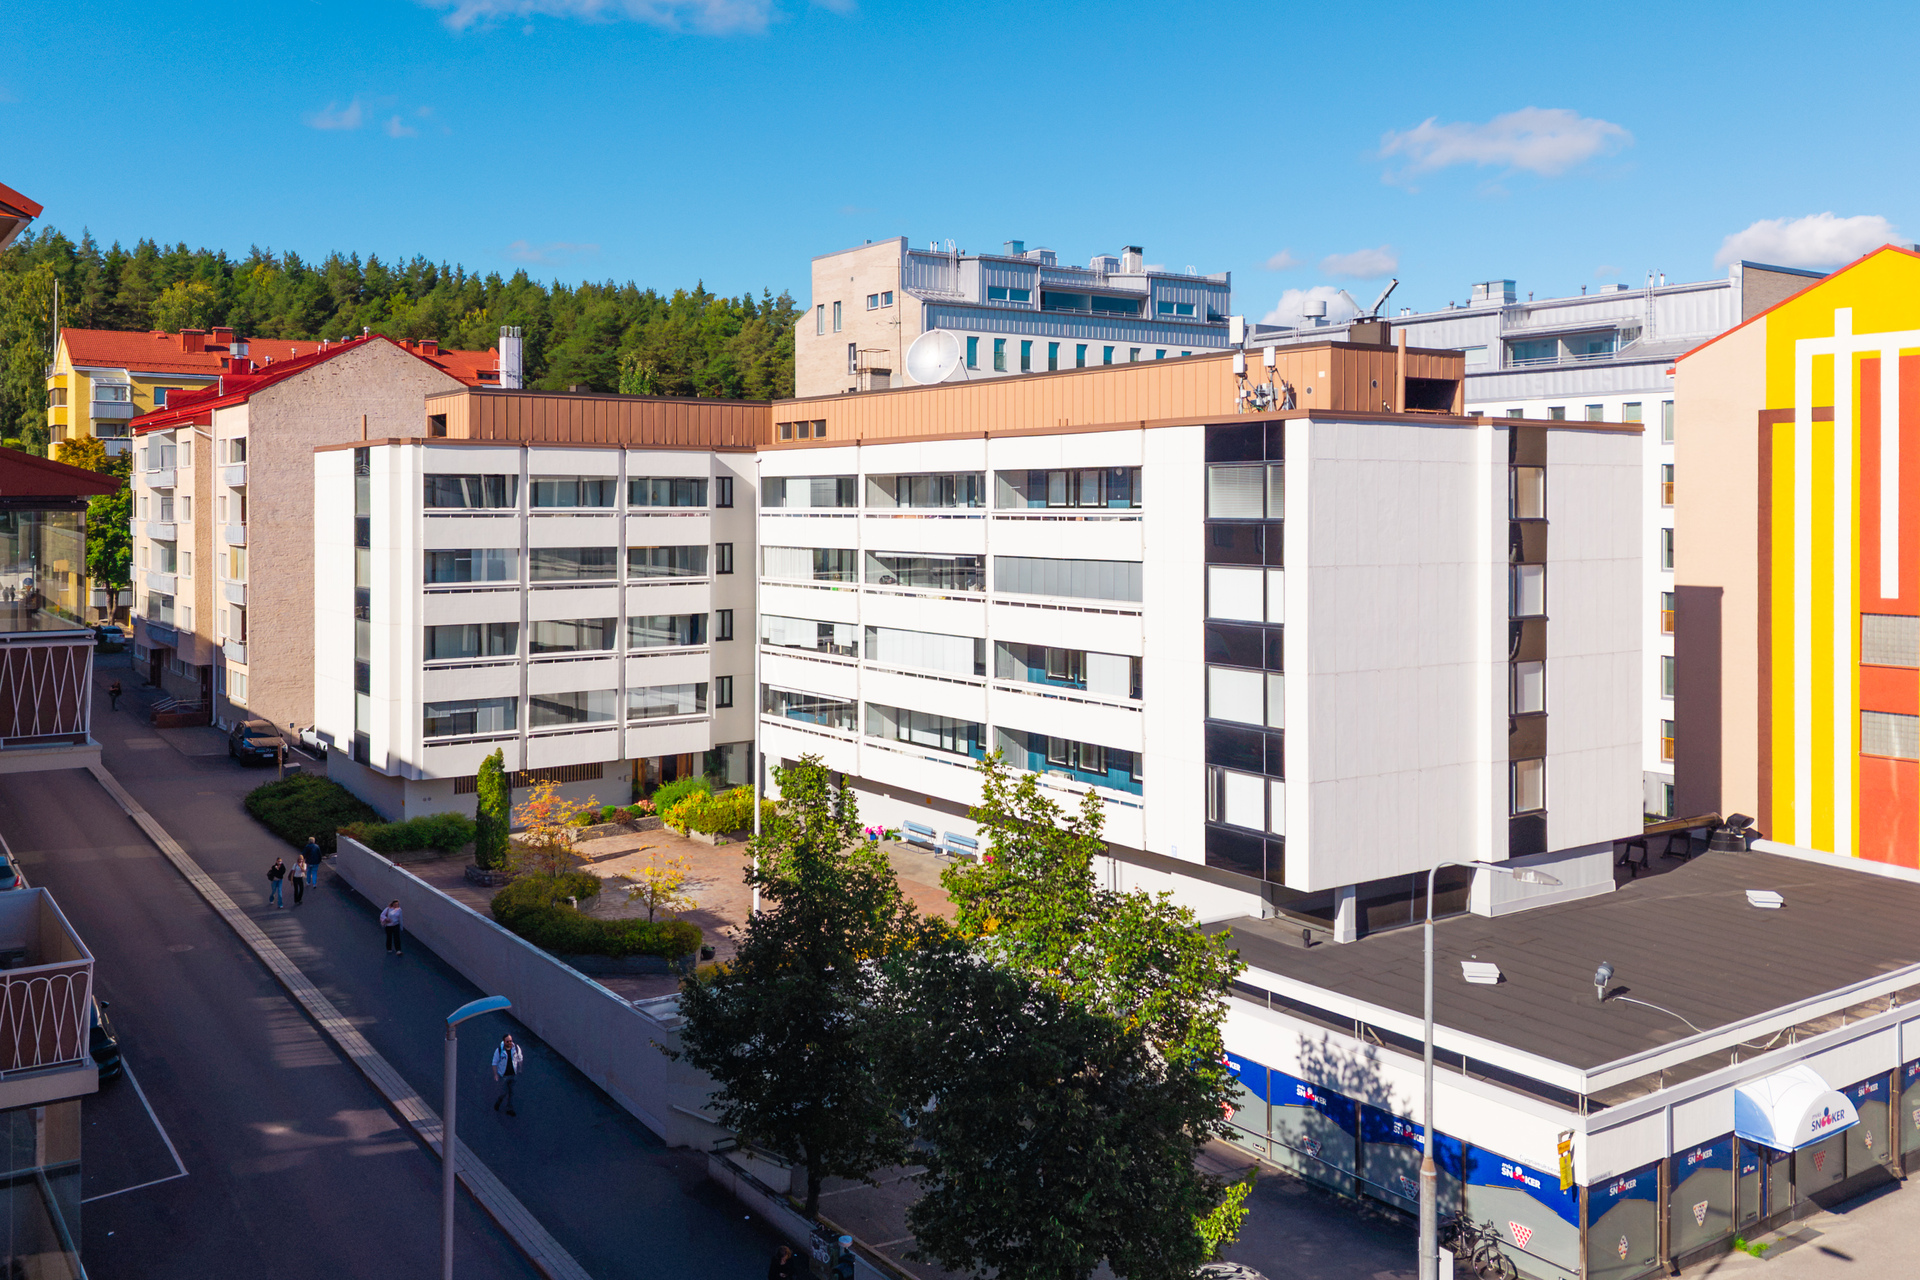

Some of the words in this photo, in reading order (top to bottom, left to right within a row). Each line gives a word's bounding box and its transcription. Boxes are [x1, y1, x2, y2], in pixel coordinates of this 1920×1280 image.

[1811, 1109, 1845, 1132] SNOOKER
[1393, 1124, 1425, 1145] SNOOKE
[1687, 1149, 1713, 1166] SNOOKER
[1501, 1166, 1541, 1190] SNOOKER
[1609, 1179, 1637, 1197] SNOOKER
